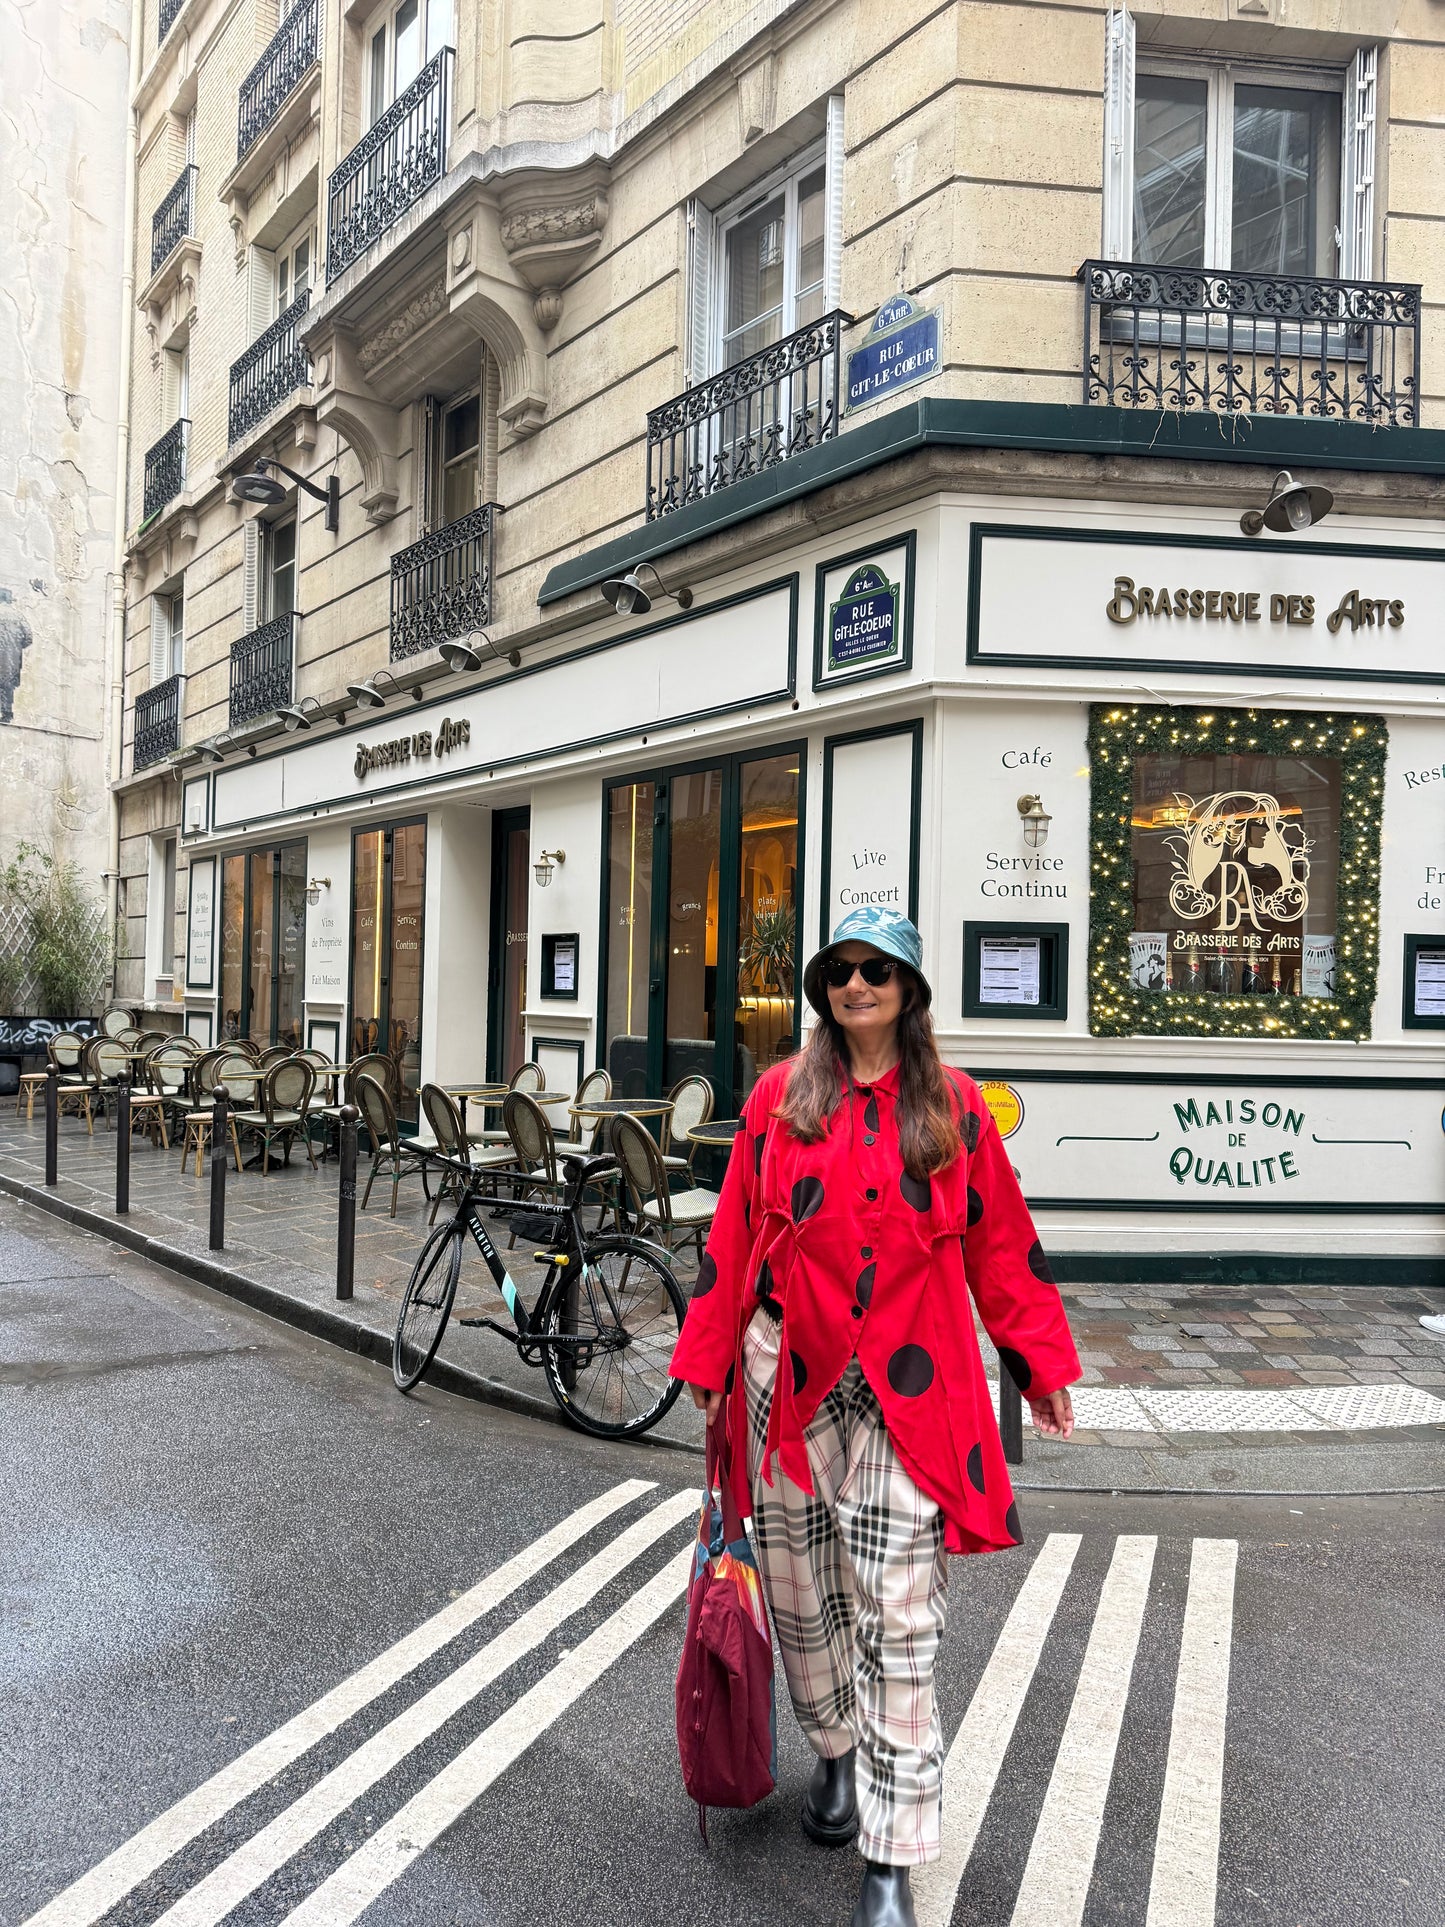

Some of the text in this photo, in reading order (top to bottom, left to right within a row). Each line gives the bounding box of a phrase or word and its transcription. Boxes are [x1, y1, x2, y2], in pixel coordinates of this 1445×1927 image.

[879, 340, 904, 364] RUE
[852, 601, 875, 620] RUE
[1001, 746, 1052, 769] Café
[852, 848, 887, 870] Live
[986, 852, 1064, 871] Service
[839, 886, 900, 905] Concert
[980, 879, 1068, 899] Continu
[1417, 891, 1441, 909] de
[321, 918, 334, 928] Vins
[361, 916, 374, 928] Café
[397, 914, 417, 927] Service
[312, 938, 319, 948] de
[362, 941, 372, 951] Bar
[395, 939, 418, 950] Continu
[311, 974, 341, 986] Fait Maison
[984, 1081, 1007, 1090] 2025
[1173, 1097, 1306, 1136] MAISON
[1228, 1133, 1247, 1147] DE
[469, 1216, 495, 1259] AVENTON
